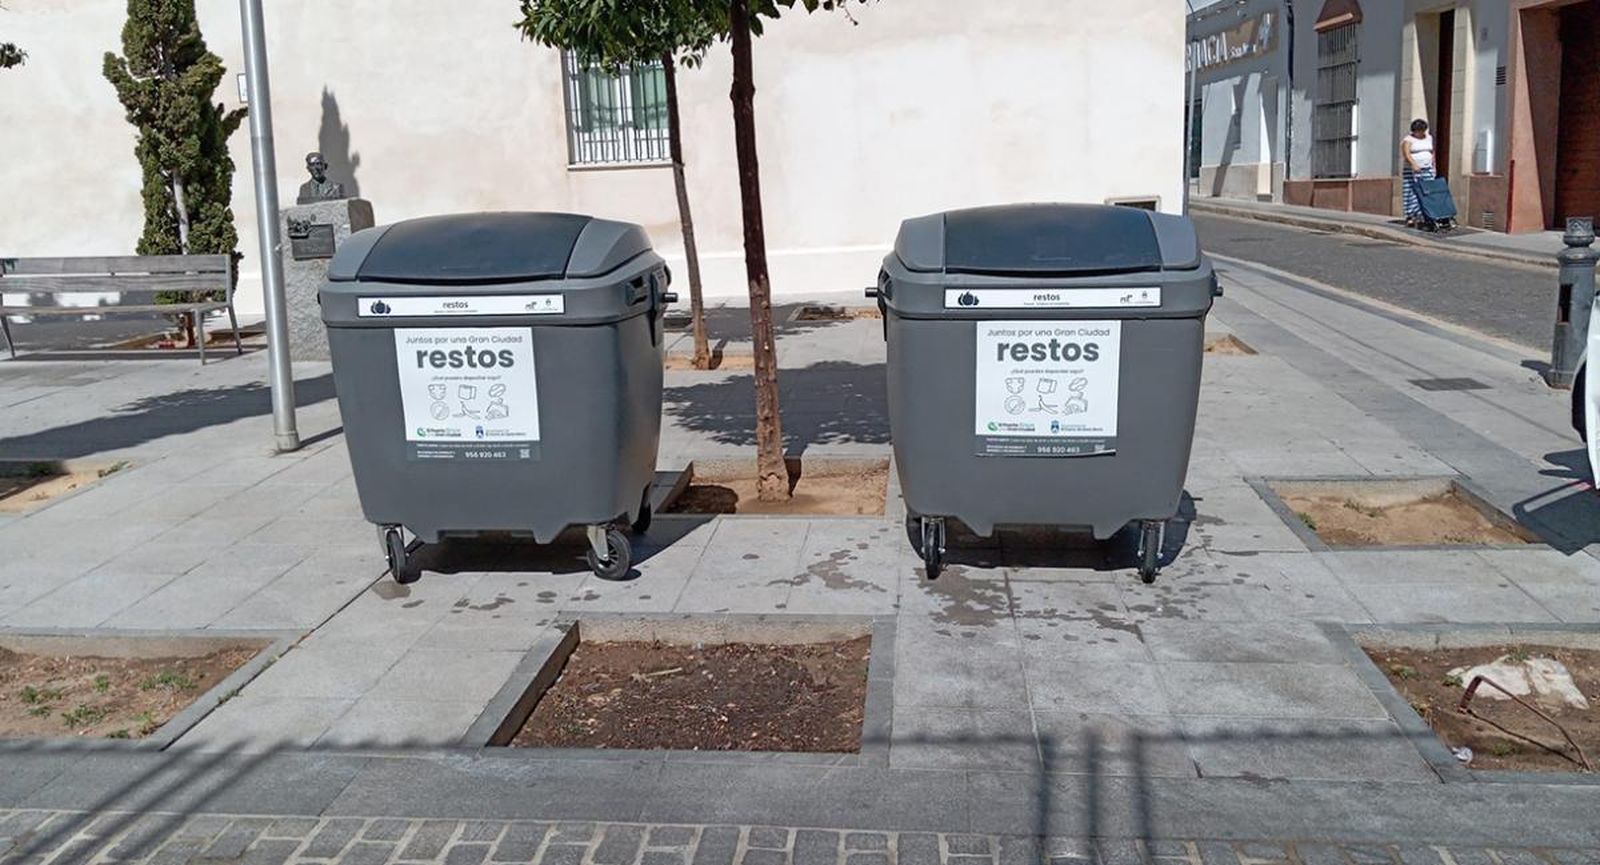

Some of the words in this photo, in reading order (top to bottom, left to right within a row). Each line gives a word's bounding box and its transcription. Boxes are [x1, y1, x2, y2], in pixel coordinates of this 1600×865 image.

[1033, 293, 1061, 302] restos
[442, 300, 469, 309] restos
[987, 329, 1016, 337] Juntos
[1018, 330, 1032, 338] por
[1054, 328, 1076, 337] Gran
[1078, 328, 1110, 337] Ciudad
[406, 336, 433, 344] Juntos
[435, 337, 449, 345] por
[468, 335, 490, 344] Gran
[491, 335, 523, 344] Ciudad
[997, 338, 1100, 362] restos
[416, 345, 515, 369] restos
